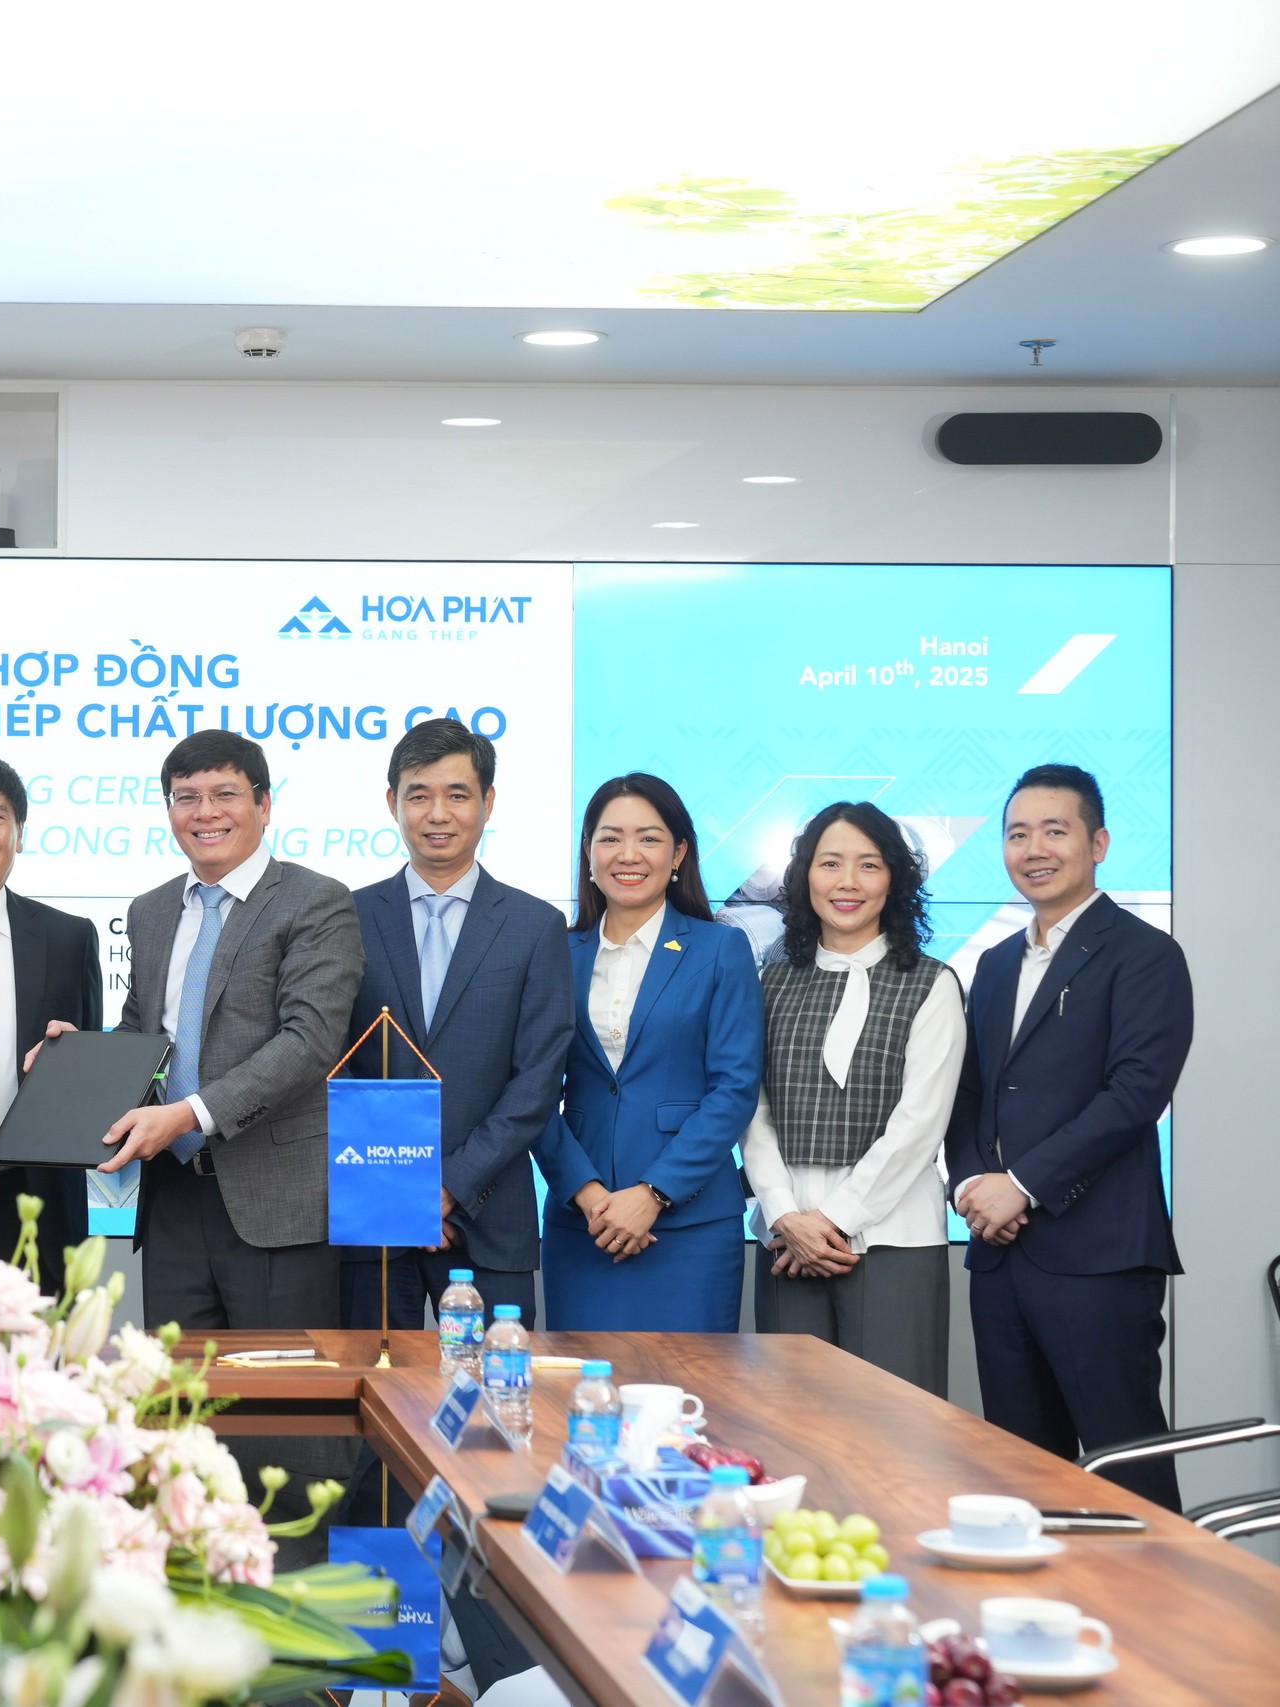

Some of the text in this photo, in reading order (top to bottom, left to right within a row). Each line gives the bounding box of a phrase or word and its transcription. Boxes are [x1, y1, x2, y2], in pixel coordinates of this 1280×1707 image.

[361, 627, 479, 641] GANG THÉP
[919, 636, 989, 656] Hanoi
[94, 638, 240, 689] ĐỒNG
[799, 665, 857, 691] April
[929, 666, 989, 687] 2025
[76, 690, 204, 738] CHẤT
[220, 703, 388, 751] LƯỢNG
